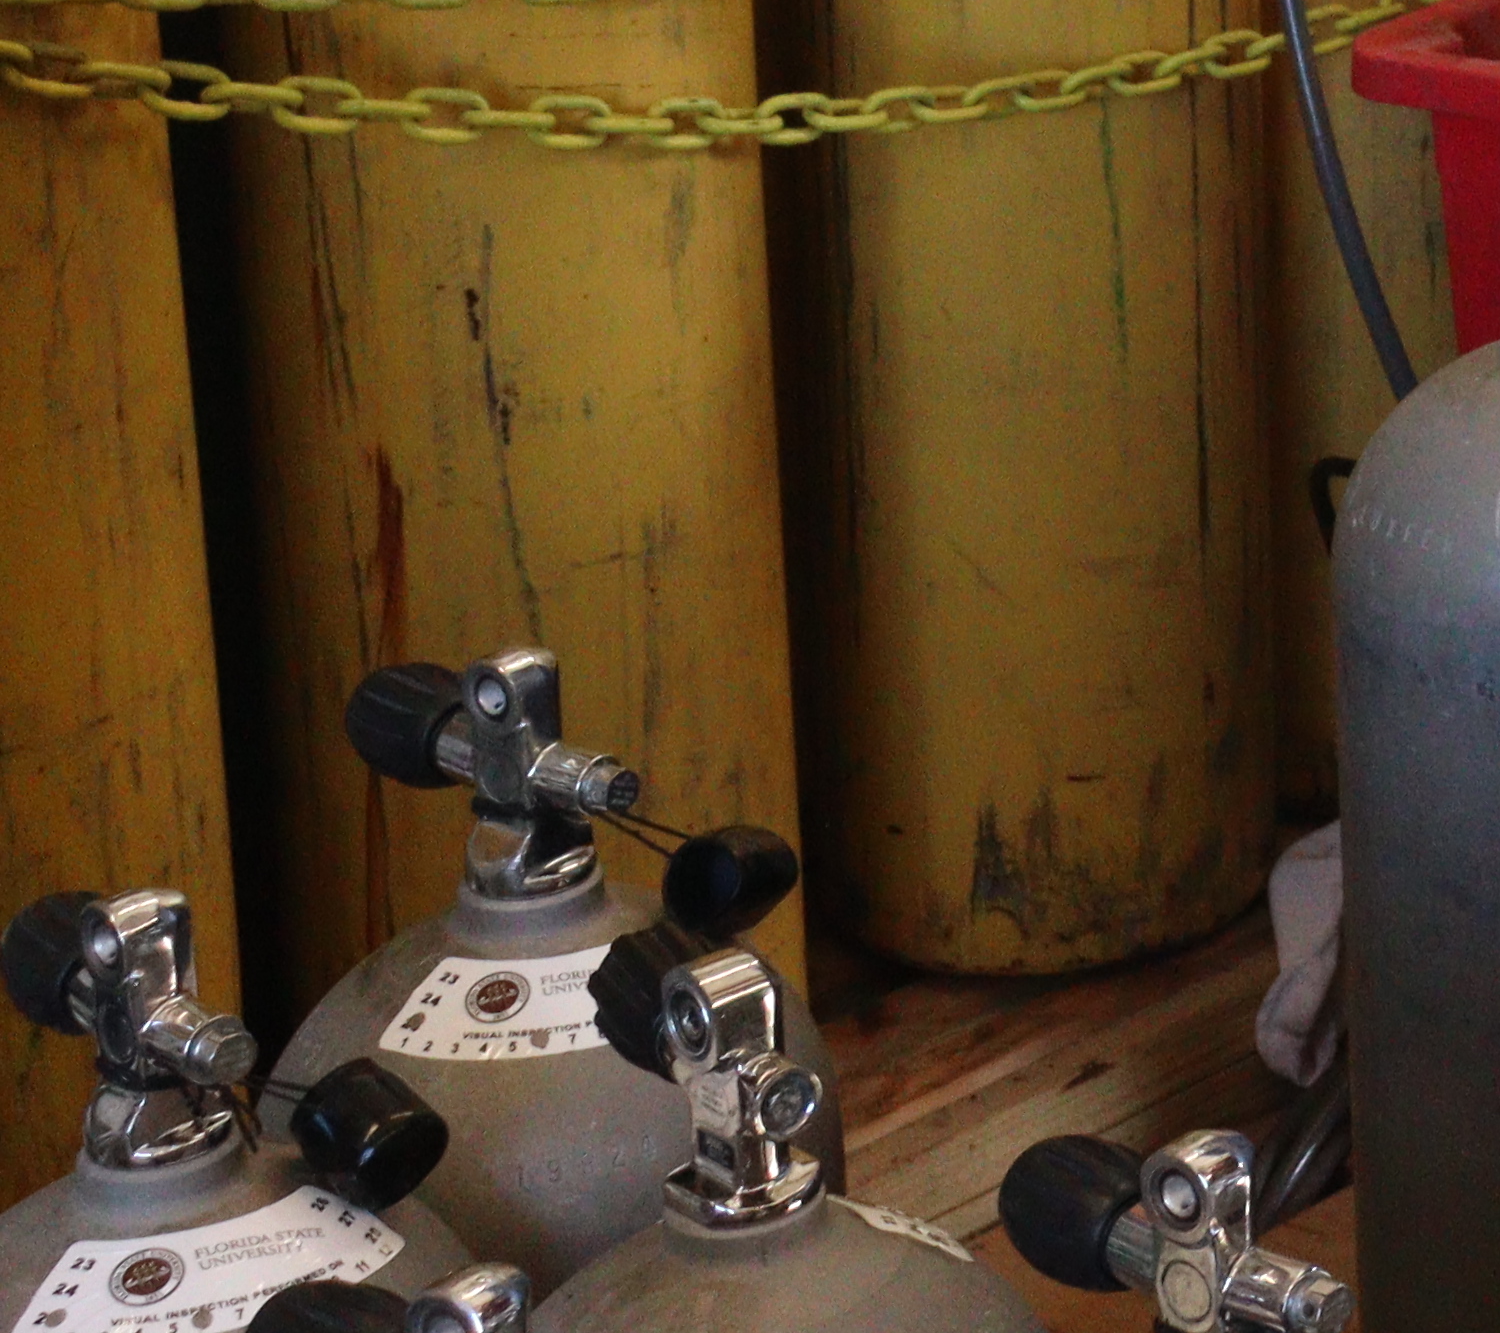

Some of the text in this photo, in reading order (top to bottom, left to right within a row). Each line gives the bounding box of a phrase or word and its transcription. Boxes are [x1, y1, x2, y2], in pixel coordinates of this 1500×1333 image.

[438, 971, 461, 985] 23
[420, 992, 442, 1007] 24
[462, 1022, 581, 1040] VISUAL INSPECTION
[400, 1033, 578, 1054] 1 2 3 4 5 7
[338, 1210, 356, 1227] 27
[194, 1227, 326, 1261] FLORIDA STATE
[70, 1257, 97, 1272] 23
[199, 1241, 305, 1271] UNIVERSITY
[52, 1282, 81, 1297] 24
[110, 1312, 161, 1328] VISUAL
[165, 1293, 249, 1320] INSPECTION
[234, 1307, 245, 1321] 7
